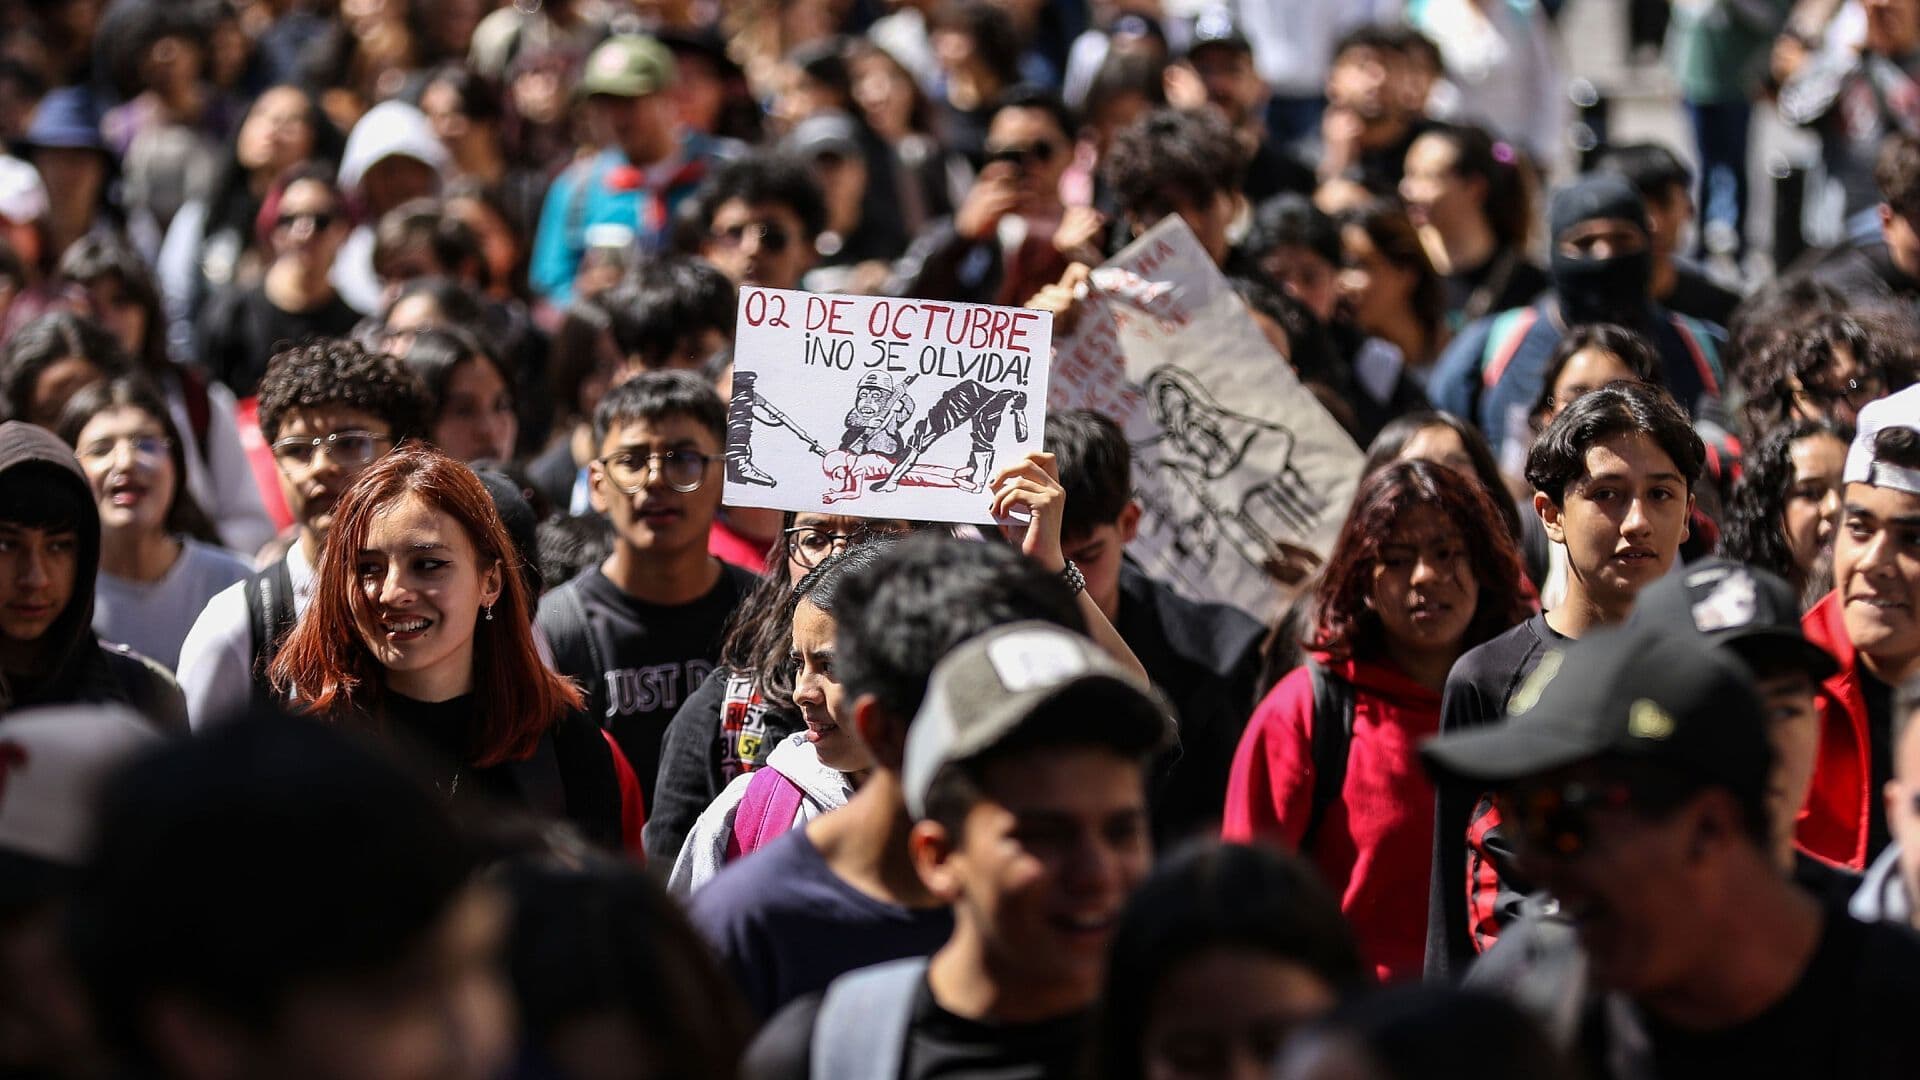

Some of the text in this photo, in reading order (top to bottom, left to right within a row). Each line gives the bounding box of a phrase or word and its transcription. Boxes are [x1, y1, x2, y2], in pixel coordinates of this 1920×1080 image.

[745, 290, 1039, 353] 02 DE OCTUBRE
[863, 339, 909, 372] SE
[919, 345, 1031, 386] OLVIDA!
[604, 662, 680, 718] JUST
